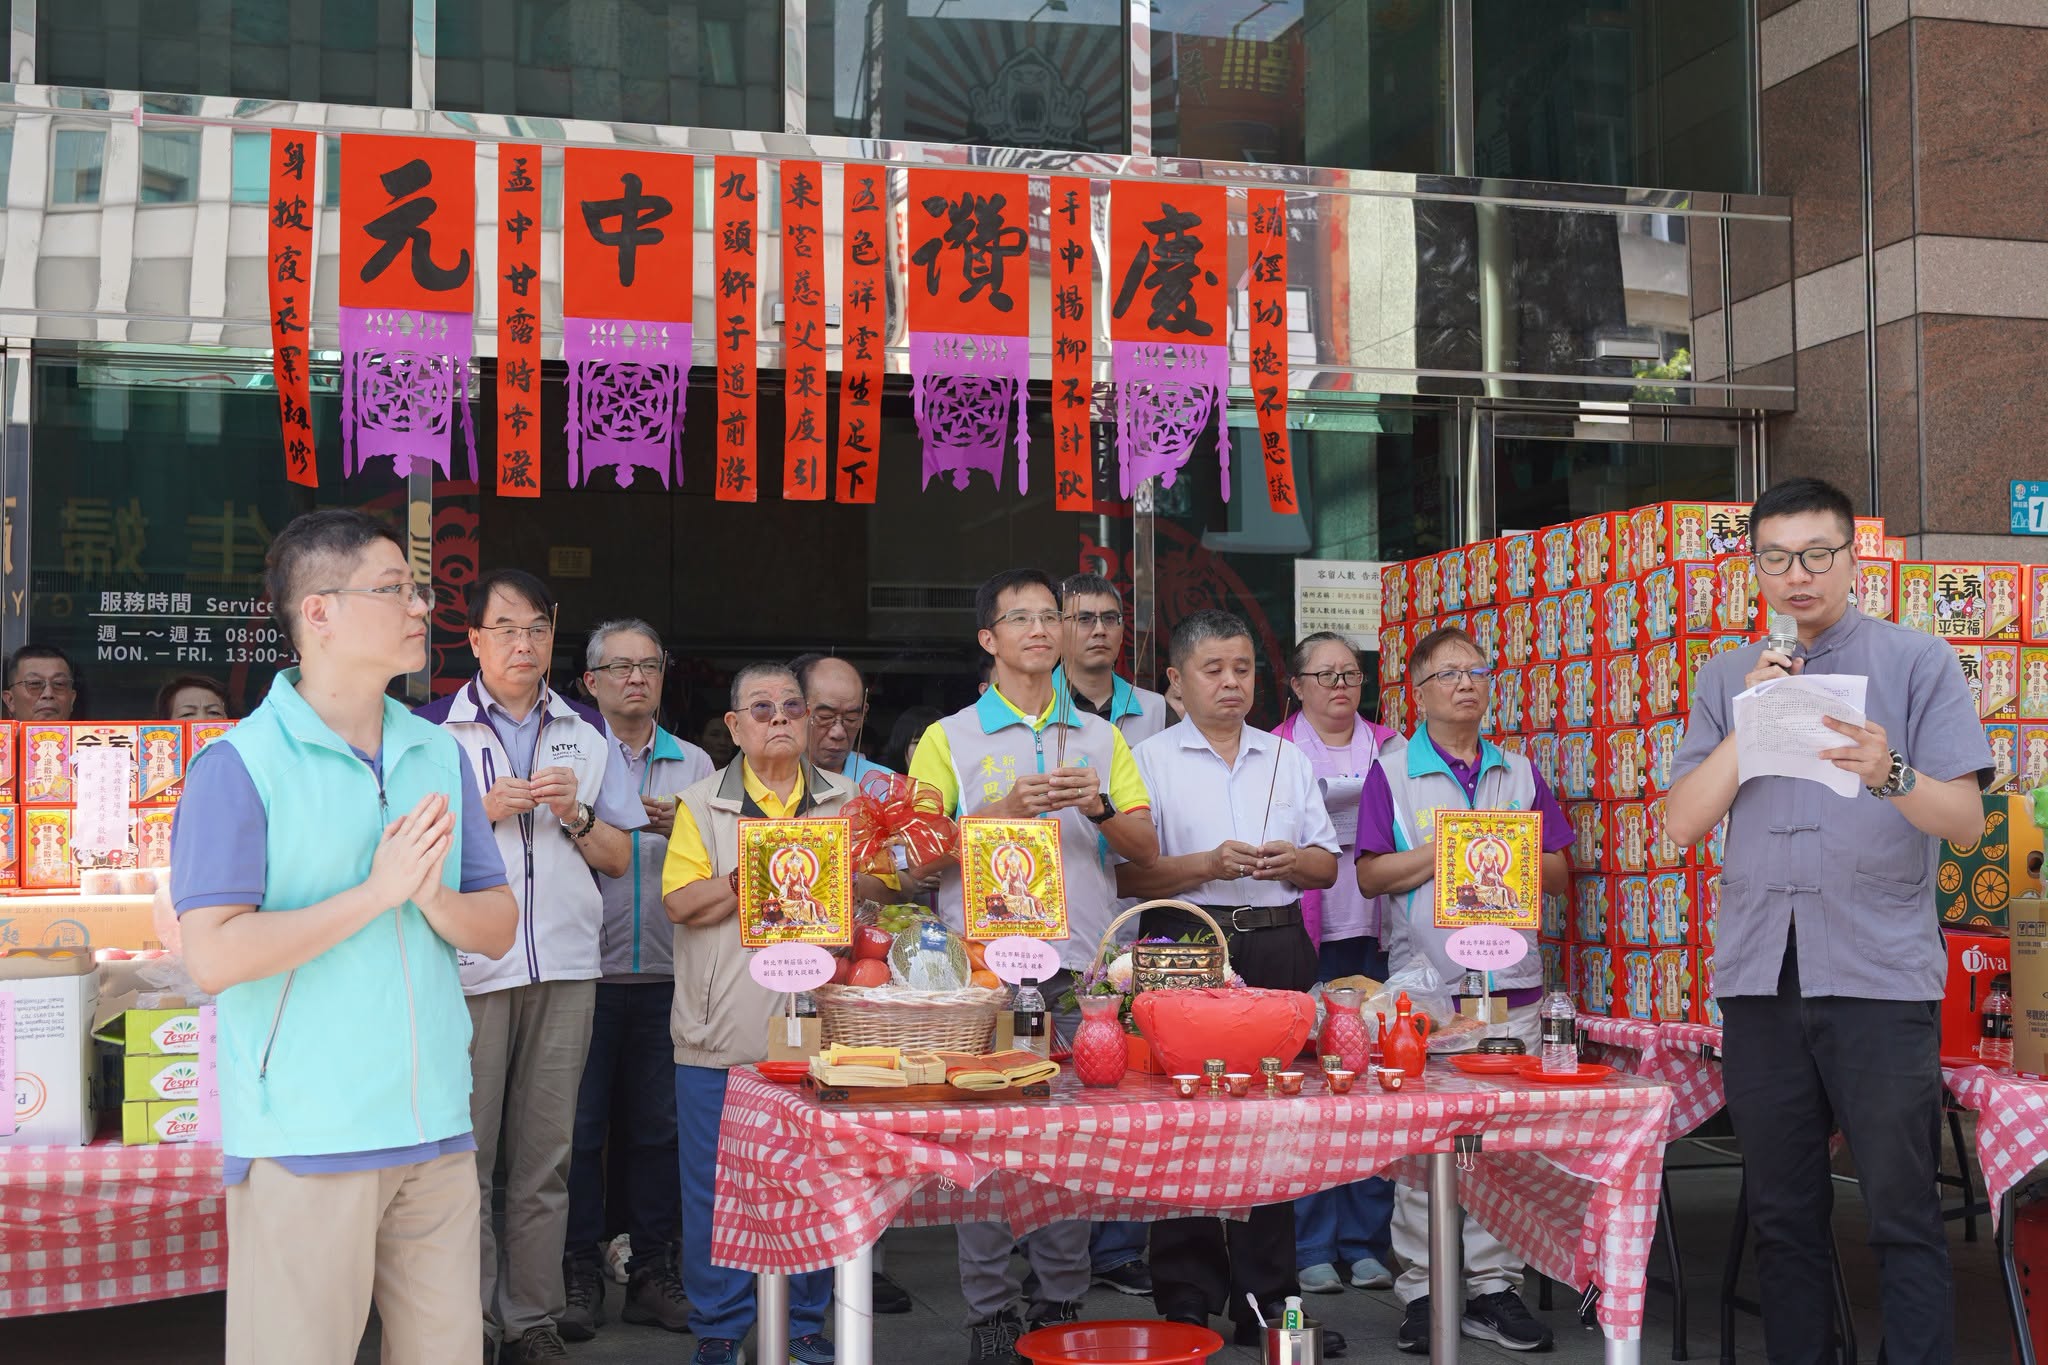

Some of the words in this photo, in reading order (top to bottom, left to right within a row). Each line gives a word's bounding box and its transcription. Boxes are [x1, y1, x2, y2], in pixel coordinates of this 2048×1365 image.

[360, 158, 470, 292] 元
[581, 173, 673, 287] 中
[1112, 202, 1219, 337] 慶
[840, 176, 881, 500] 五色祥雲生足下
[1317, 570, 1356, 580] 容留人數
[1361, 572, 1380, 581] 告示
[1699, 578, 1708, 616] 小人退散符
[1938, 573, 1982, 602] 全家
[100, 591, 192, 613] 服務時間
[206, 597, 275, 614] Service
[1938, 619, 1980, 636] 平安福
[97, 646, 149, 662] MON.
[177, 647, 213, 662] FRI.
[1968, 952, 2008, 971] Diva
[162, 1030, 199, 1045] Zespri
[162, 1077, 199, 1091] Zespri
